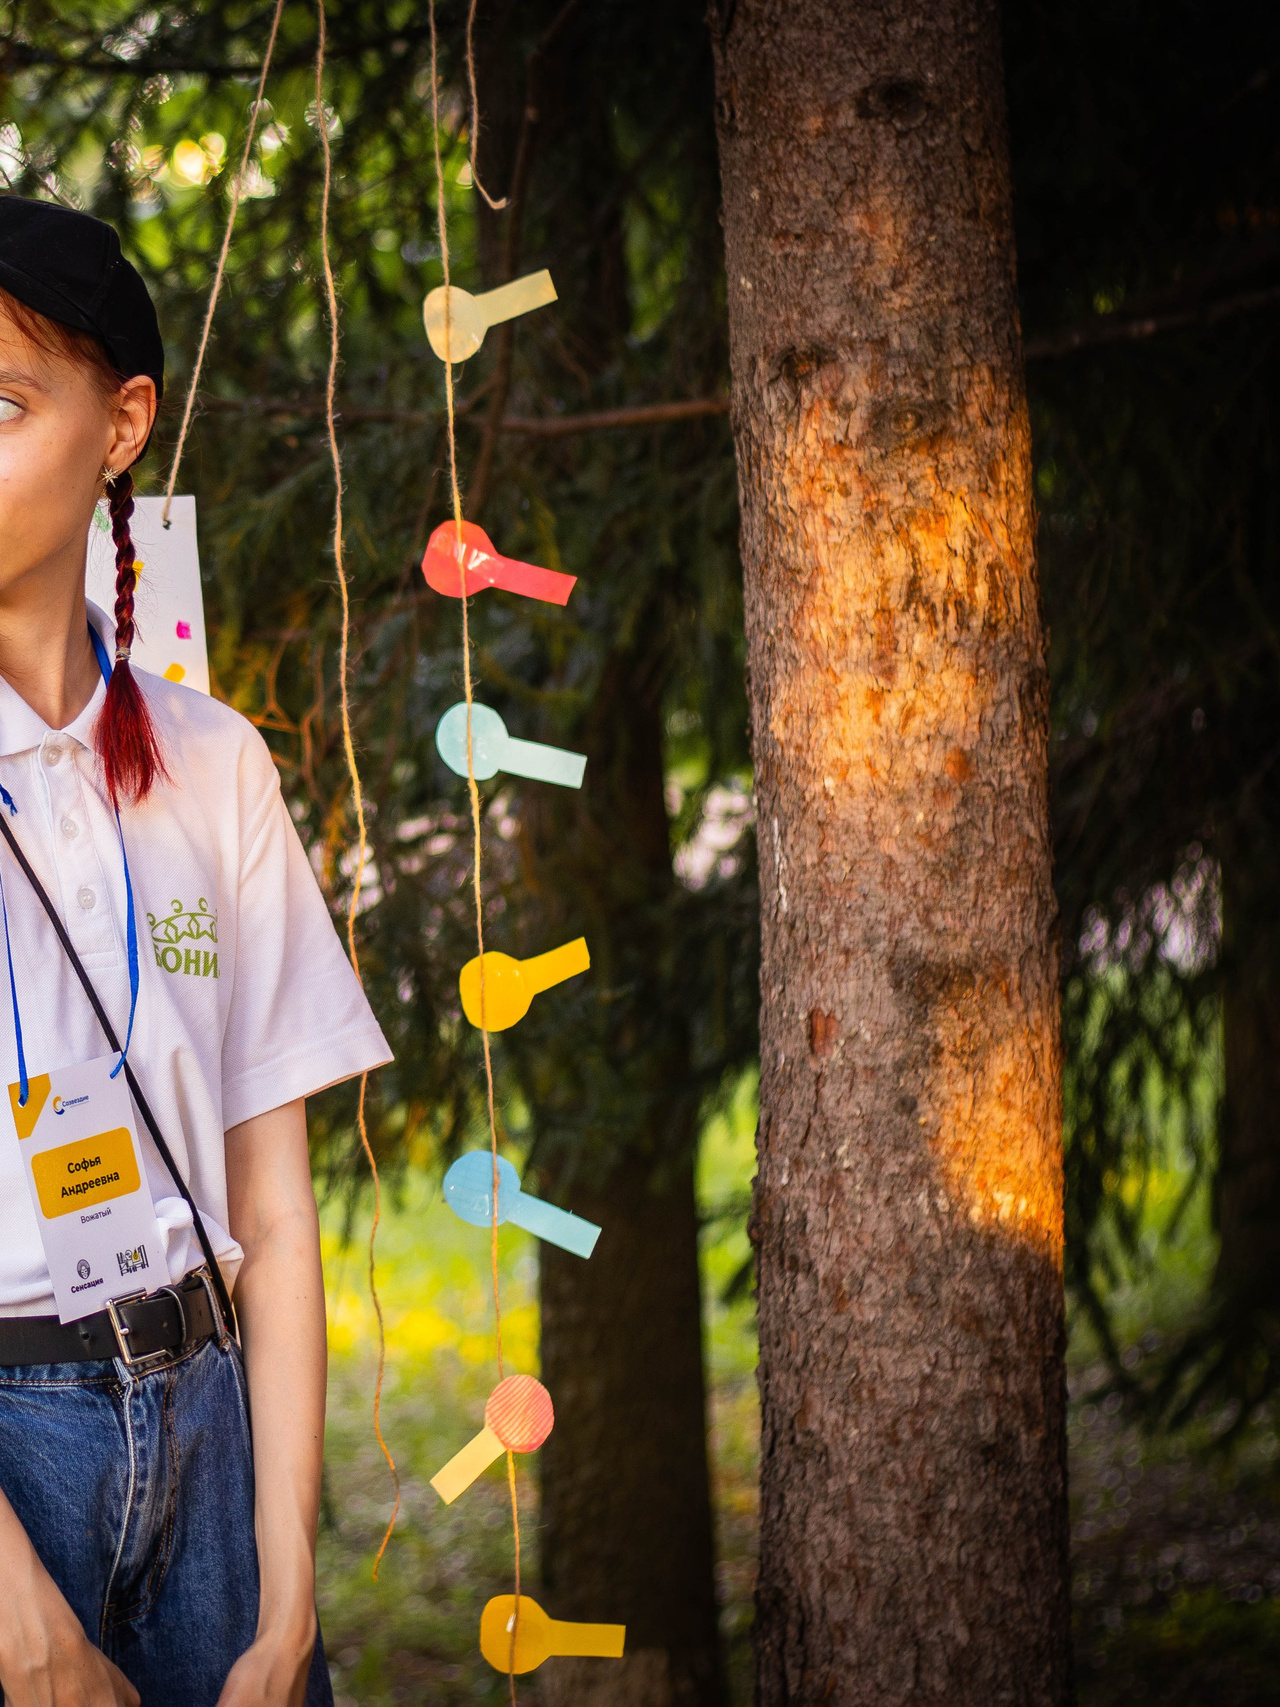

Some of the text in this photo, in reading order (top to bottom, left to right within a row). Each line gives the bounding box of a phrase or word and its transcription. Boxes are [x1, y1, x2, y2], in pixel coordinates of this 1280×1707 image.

[152, 942, 220, 978] БОНИ
[67, 1156, 101, 1174] Софья
[61, 1171, 120, 1198] Андреевна
[80, 1207, 112, 1224] Вожатый
[71, 1278, 104, 1293] Сенсация
